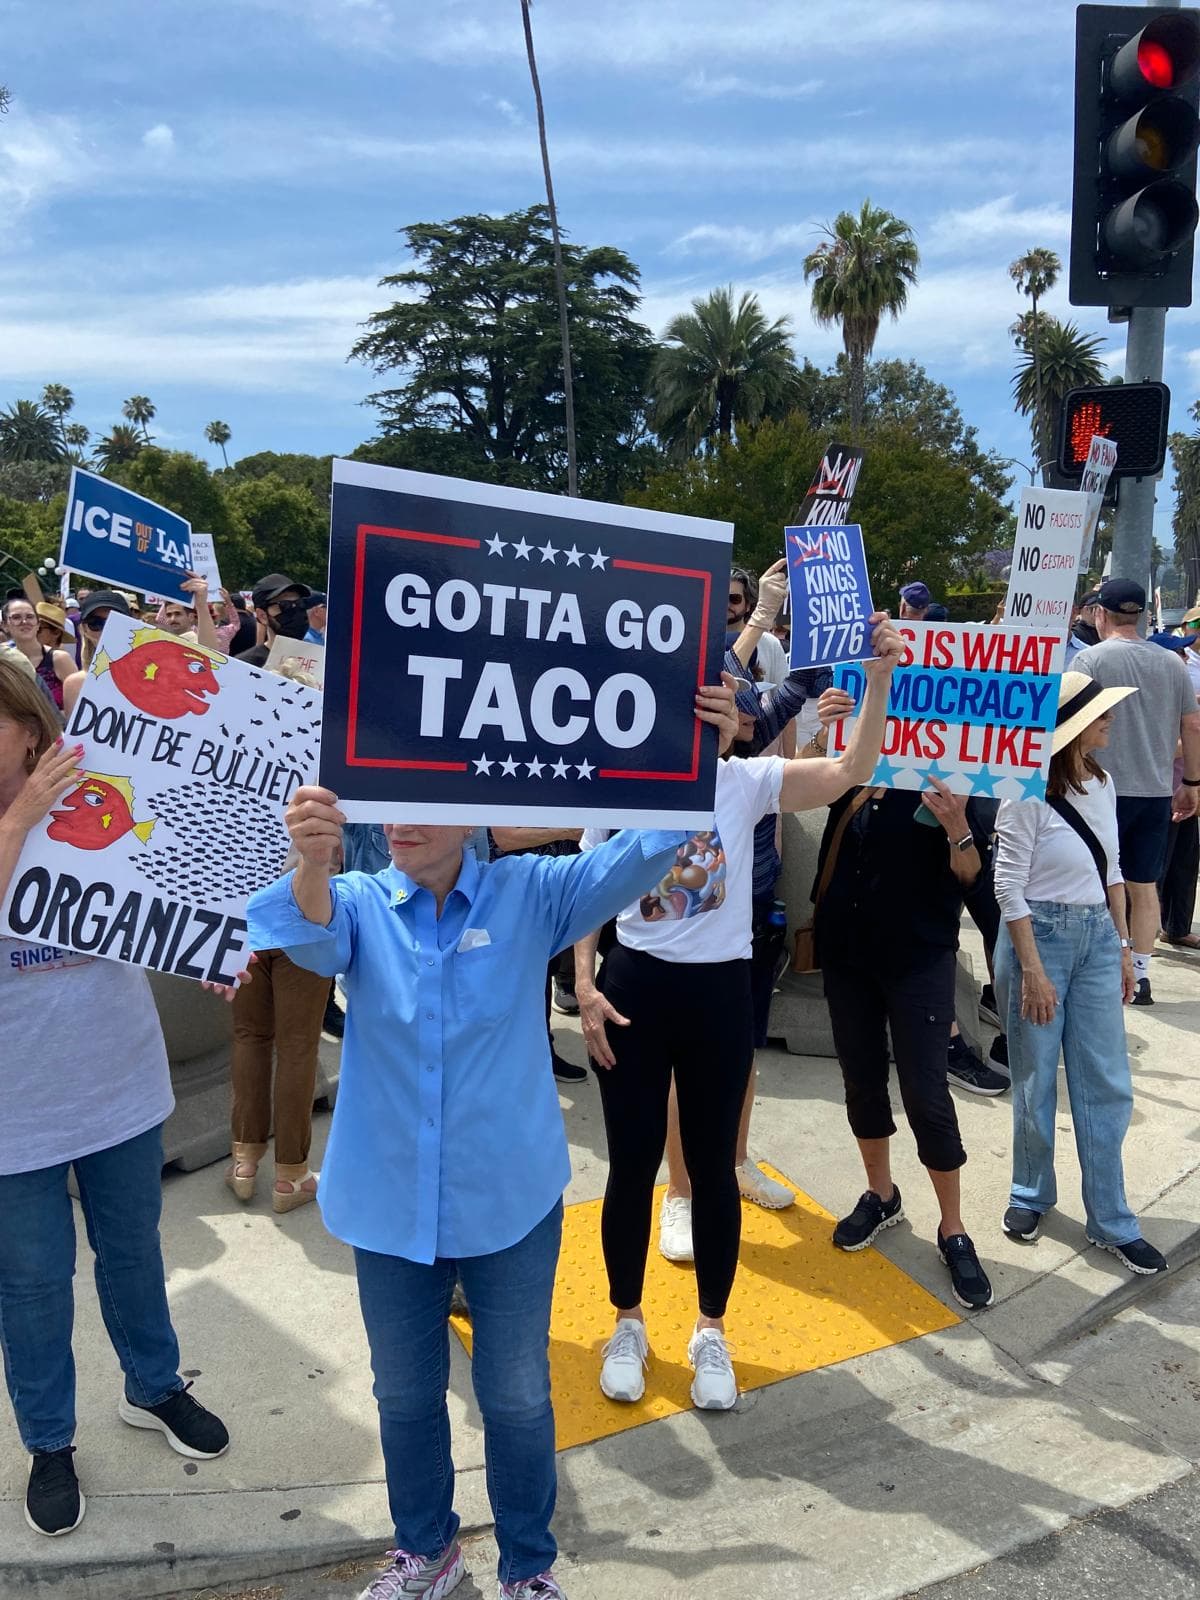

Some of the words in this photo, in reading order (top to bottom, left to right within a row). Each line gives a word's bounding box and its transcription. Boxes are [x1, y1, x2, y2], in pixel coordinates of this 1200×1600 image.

[72, 500, 133, 548] ICE
[135, 522, 153, 540] OUT
[1024, 503, 1046, 530] NO
[1049, 512, 1083, 529] FASCISTS
[137, 538, 150, 553] OF
[823, 531, 850, 562] NO
[1018, 547, 1041, 572] NO
[1041, 554, 1075, 570] GESTAPO
[804, 563, 858, 595] KINGS
[385, 573, 587, 645] GOTTA
[605, 599, 686, 654] GO
[808, 593, 864, 625] SINCE
[1010, 592, 1033, 618] NO
[1034, 599, 1068, 620] KINGS!
[808, 622, 865, 661] 1776
[923, 629, 956, 669] IS
[962, 632, 1060, 677] WHAT
[407, 655, 657, 749] TACO
[840, 669, 1052, 721] DMOCRACY
[70, 696, 157, 756] DON'T
[152, 726, 191, 767] BE
[191, 738, 304, 806] BULLIED
[834, 715, 948, 760] LOKS
[958, 721, 1046, 768] LIKE
[8, 866, 248, 987] ORGANIZE
[10, 946, 64, 968] SINCE
